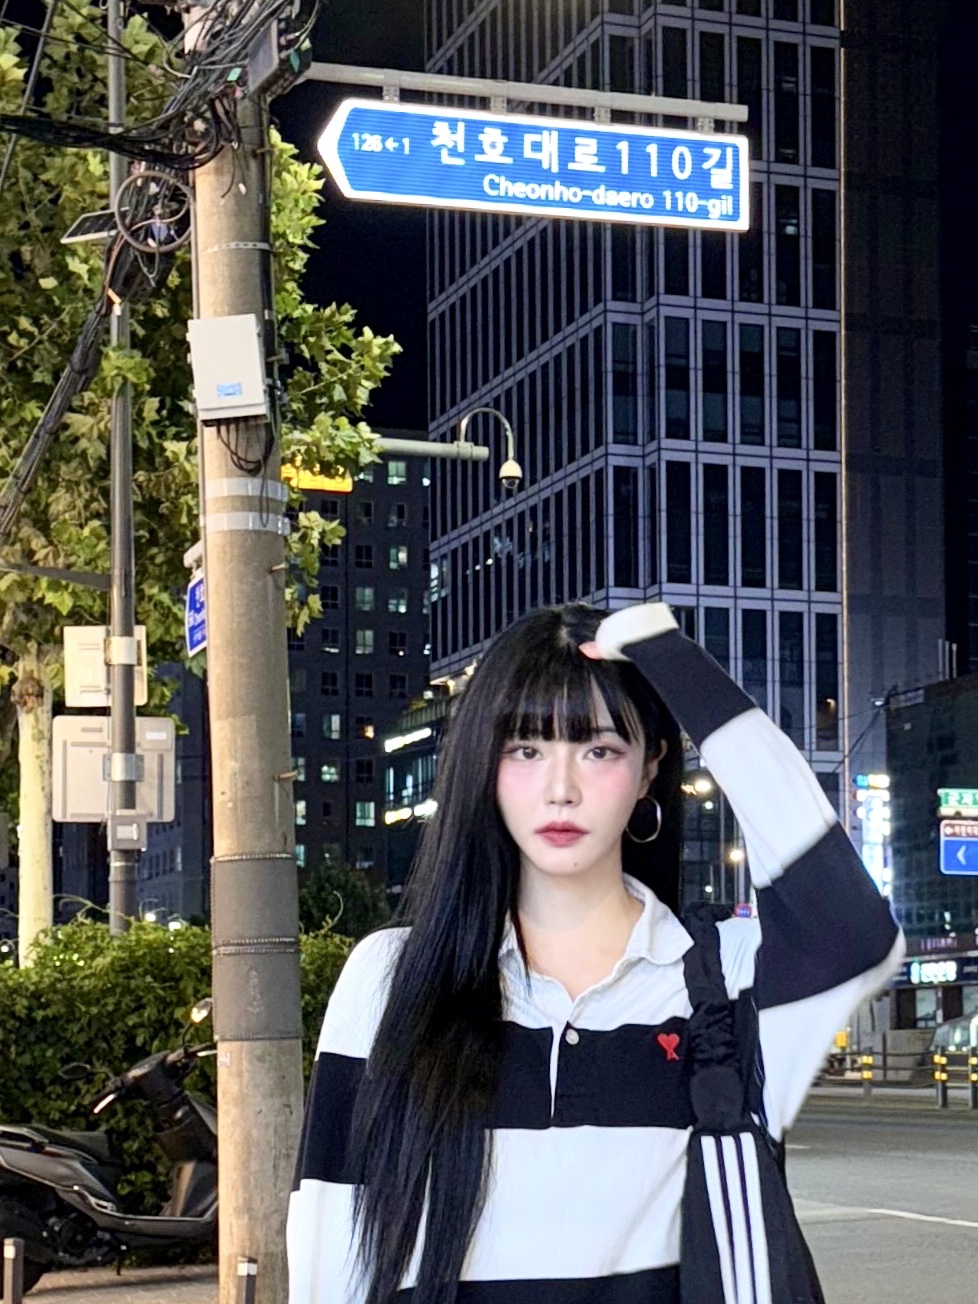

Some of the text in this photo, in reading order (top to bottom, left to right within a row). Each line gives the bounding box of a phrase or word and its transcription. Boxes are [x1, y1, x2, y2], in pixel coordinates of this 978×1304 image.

[401, 136, 411, 155] 1
[431, 120, 734, 190] 천호대로110길
[483, 173, 734, 220] Cheonho-daero 110-gil
